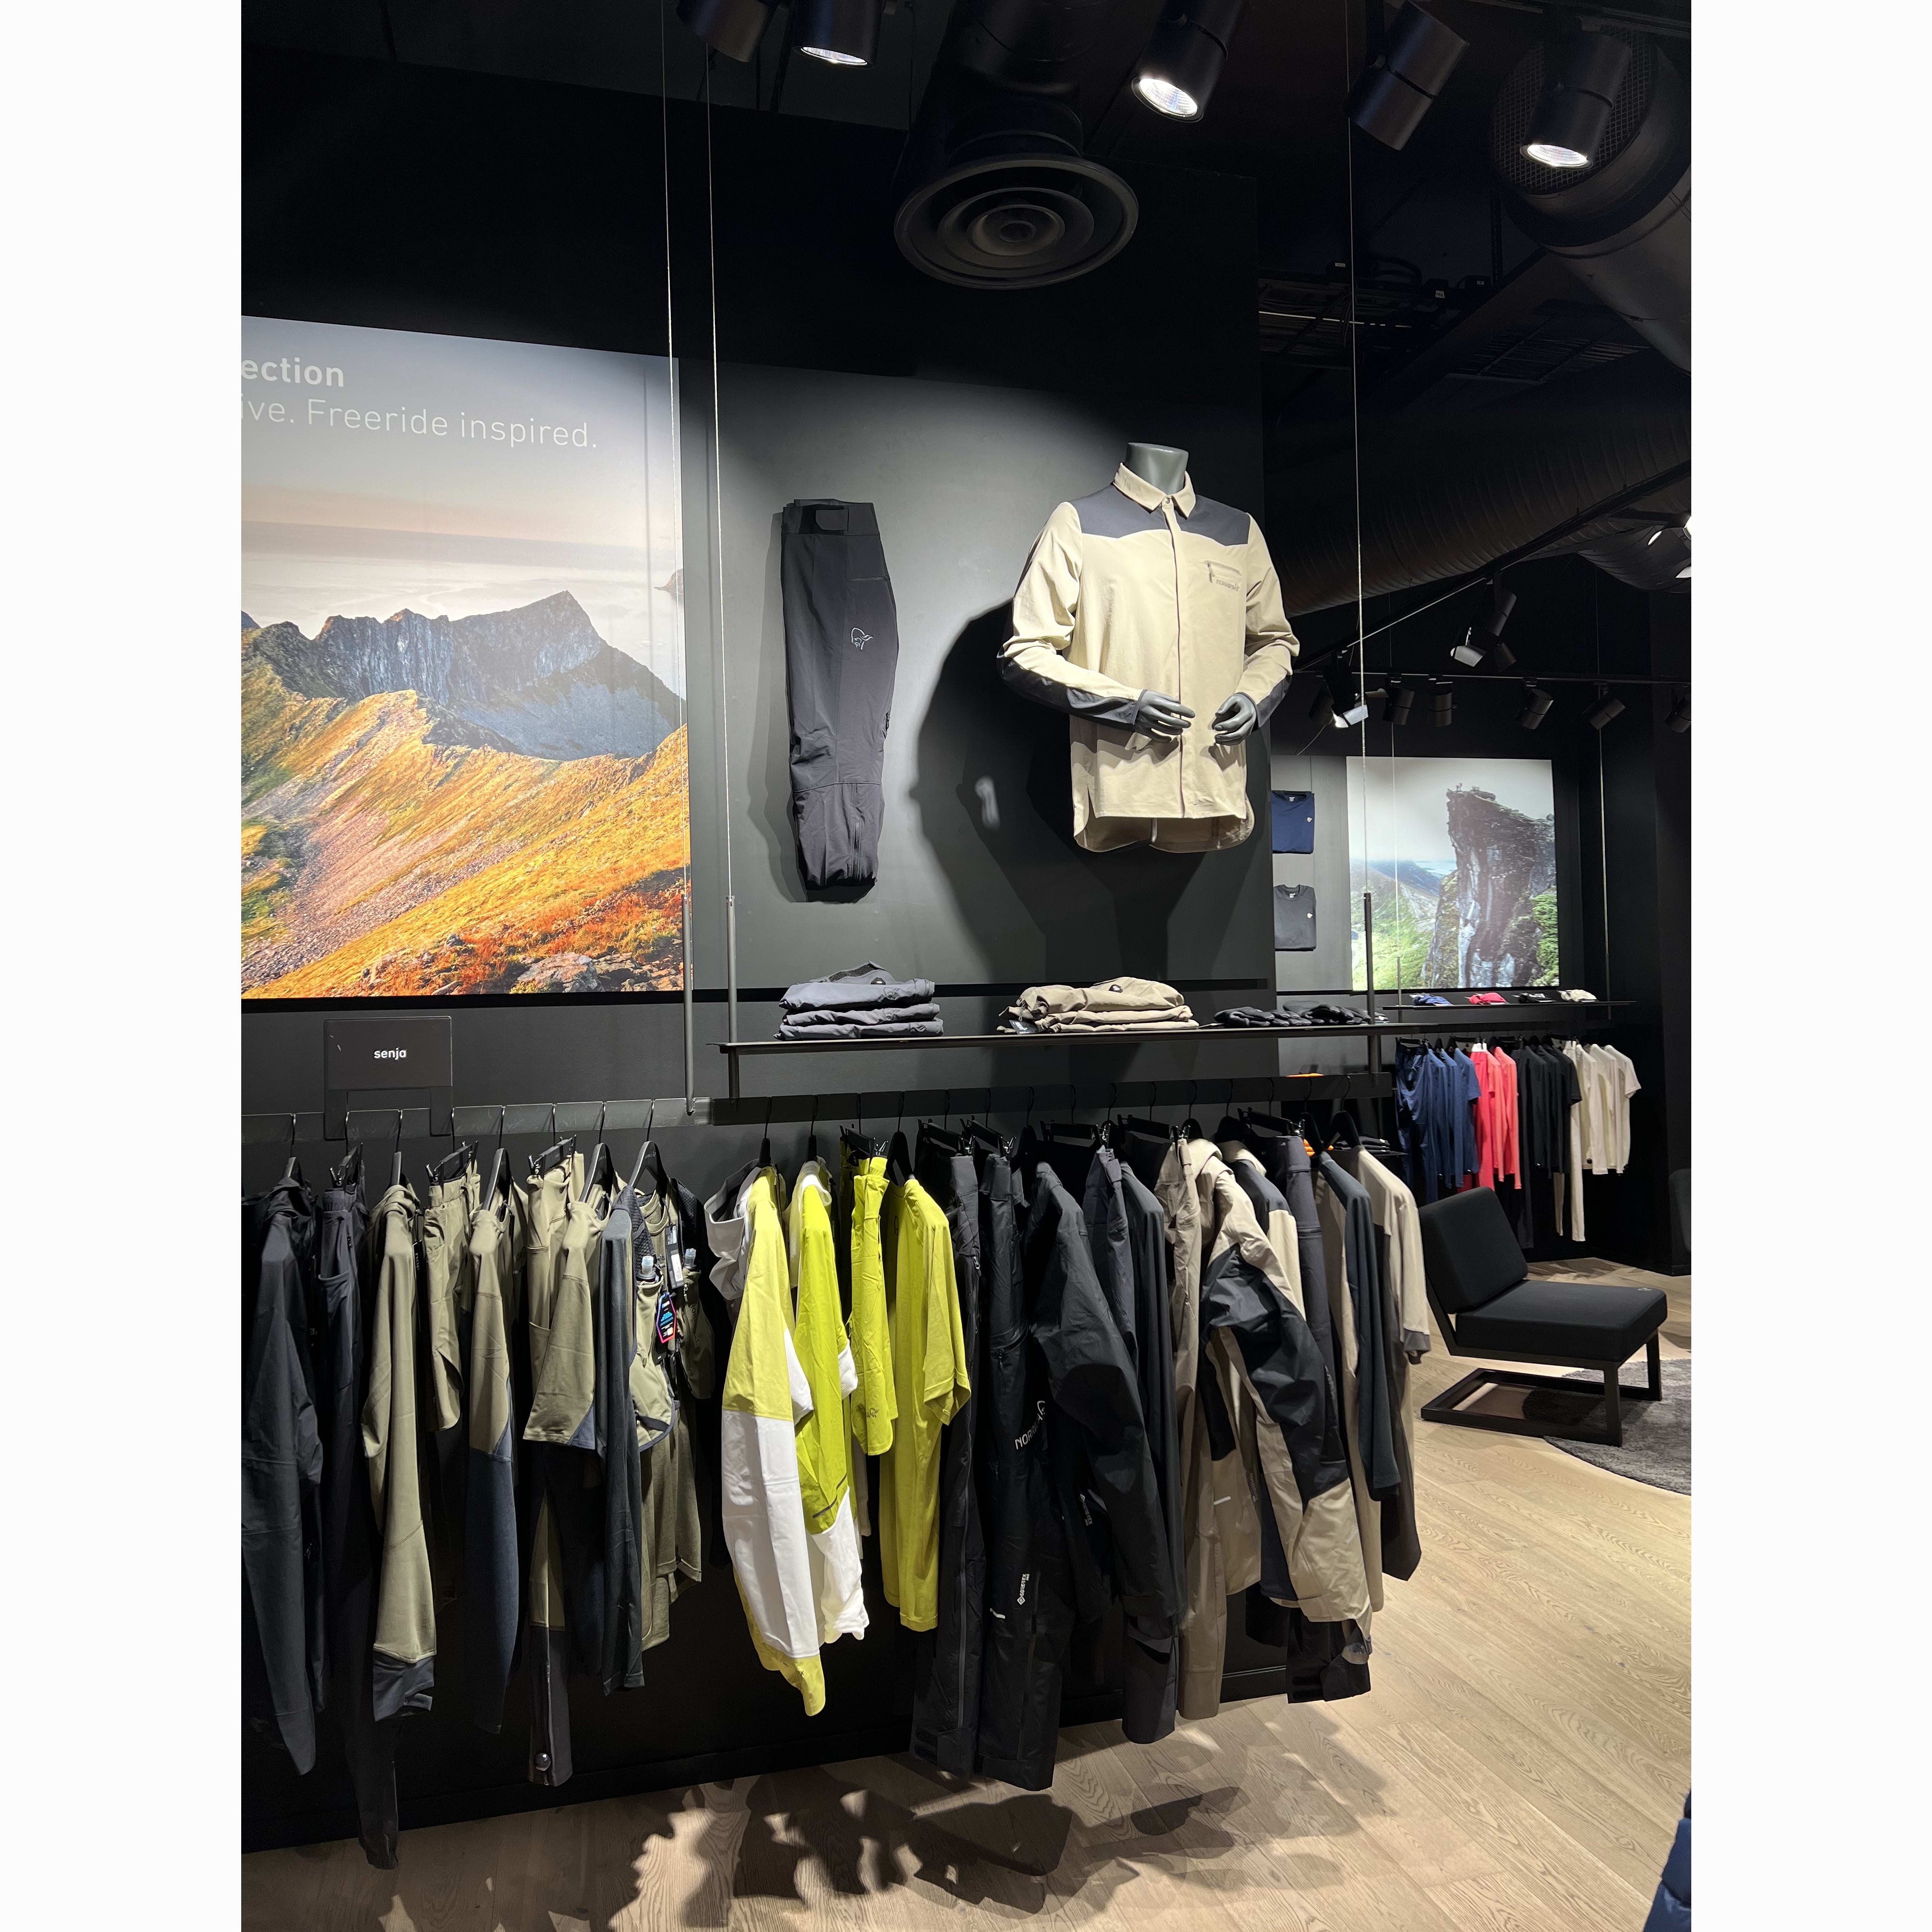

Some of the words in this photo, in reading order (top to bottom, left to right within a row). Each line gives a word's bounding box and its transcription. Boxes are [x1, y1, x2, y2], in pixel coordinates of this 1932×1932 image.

[240, 357, 344, 387] ection
[240, 393, 294, 423] ive.
[307, 398, 448, 436] Freeride
[461, 411, 597, 448] inspired.
[374, 1047, 407, 1060] senja
